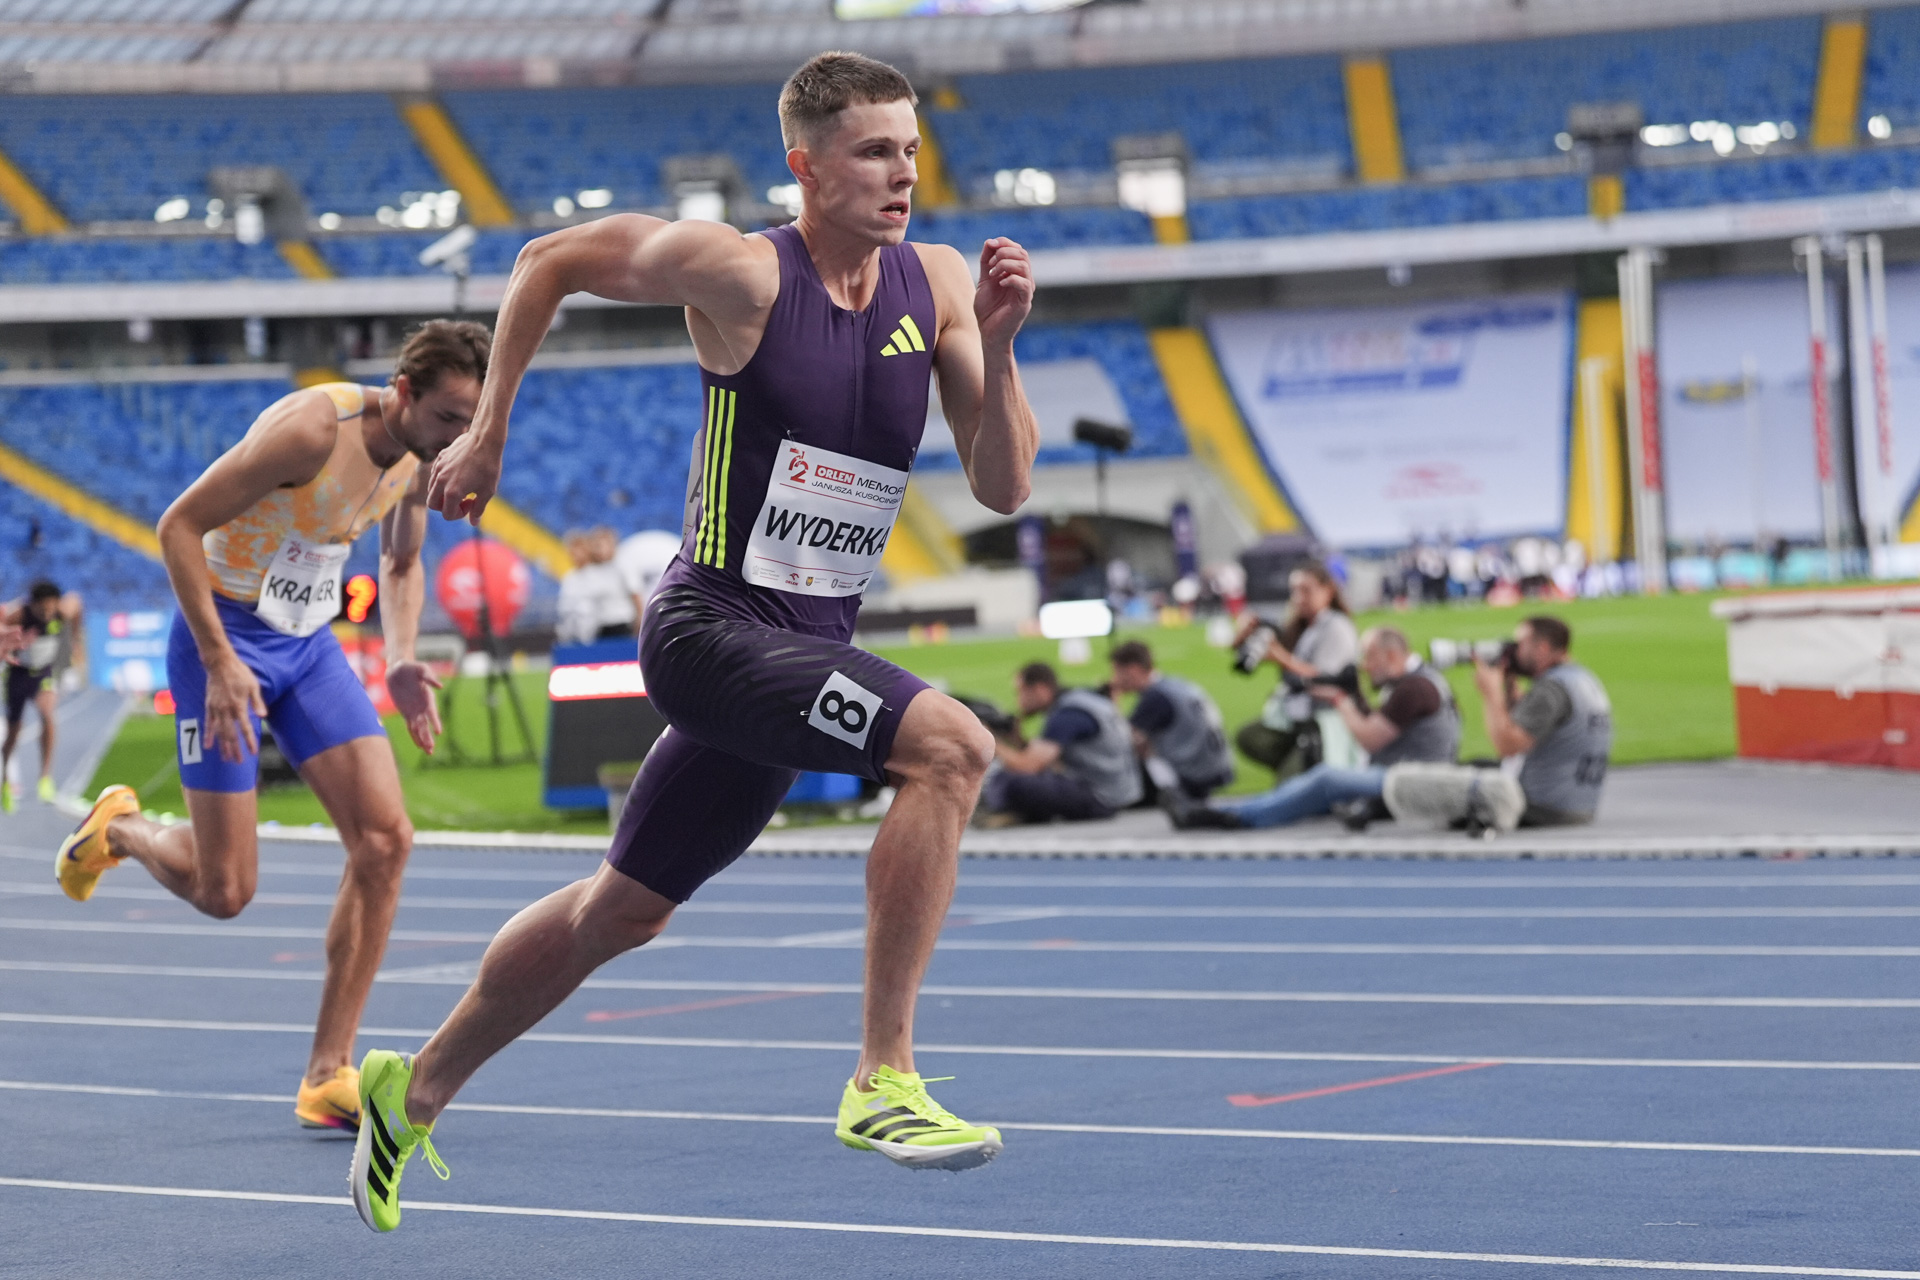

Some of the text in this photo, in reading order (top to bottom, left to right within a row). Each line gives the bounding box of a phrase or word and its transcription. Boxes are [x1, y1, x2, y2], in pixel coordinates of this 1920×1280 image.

[812, 481, 853, 496] JANUSZA
[816, 466, 854, 484] ORLEN
[765, 505, 891, 556] WYDERKA
[266, 575, 335, 606] KRAER
[819, 690, 868, 734] 8
[185, 728, 196, 755] 7
